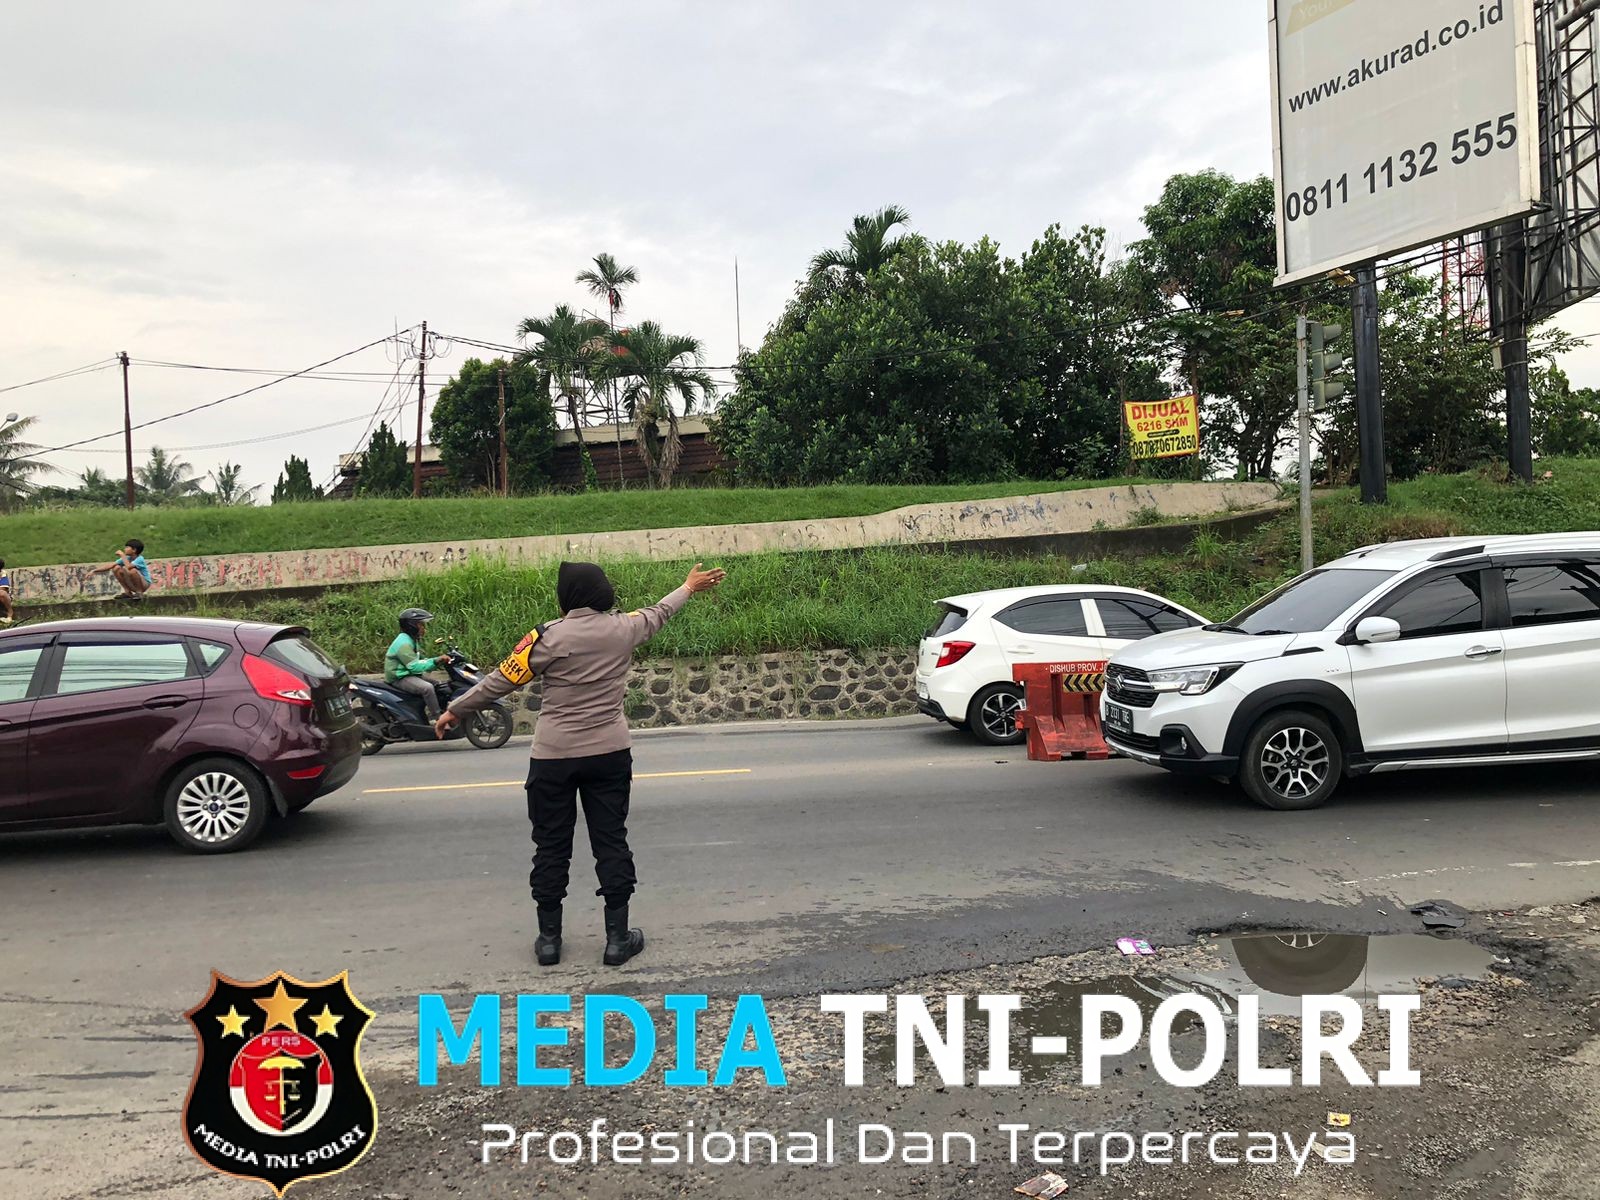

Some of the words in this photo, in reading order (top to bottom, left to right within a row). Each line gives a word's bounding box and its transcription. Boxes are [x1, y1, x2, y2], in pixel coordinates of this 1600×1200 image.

[1288, 0, 1504, 113] www.akurad.co.id
[1286, 173, 1349, 222] 0811
[1363, 141, 1438, 194] 1132
[1451, 112, 1517, 165] 555
[1132, 401, 1189, 419] DIJUAL
[1137, 420, 1162, 432] 6216
[1049, 664, 1076, 673] DISHUB
[1077, 662, 1099, 672] PROV.
